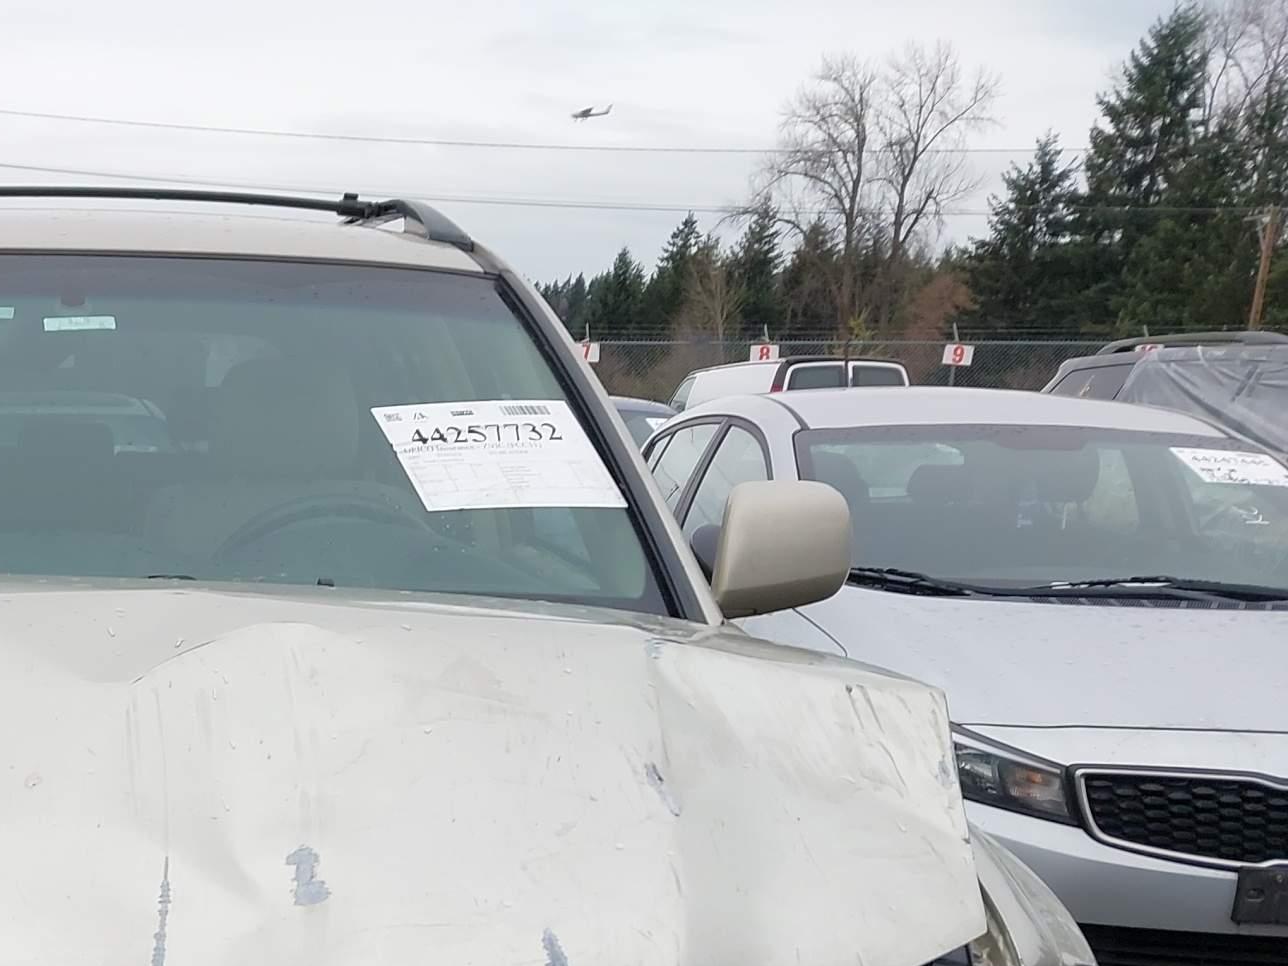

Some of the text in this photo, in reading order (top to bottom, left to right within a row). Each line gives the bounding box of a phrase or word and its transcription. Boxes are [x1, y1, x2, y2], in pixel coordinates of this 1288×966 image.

[582, 342, 592, 361] 7
[759, 345, 771, 361] 8
[952, 345, 965, 364] 9
[411, 422, 563, 445] 44257732
